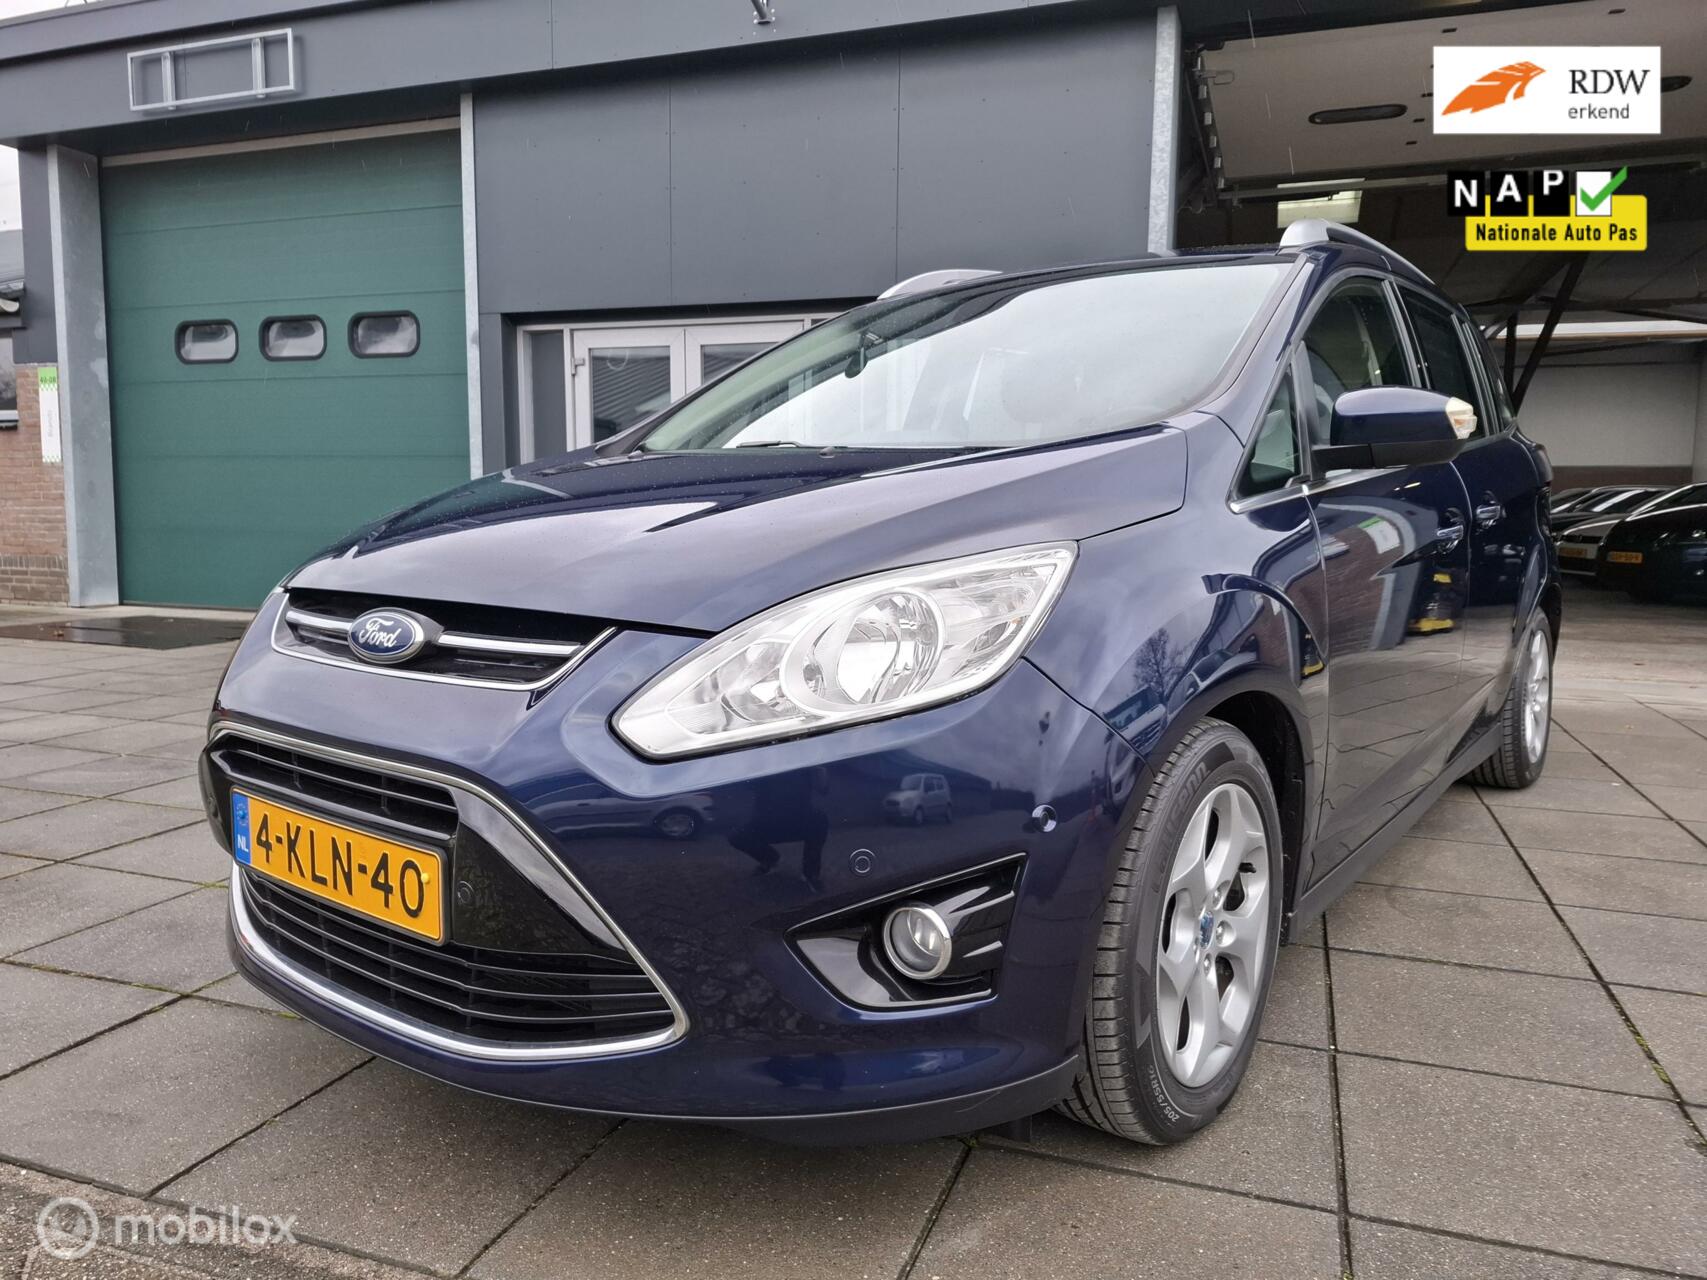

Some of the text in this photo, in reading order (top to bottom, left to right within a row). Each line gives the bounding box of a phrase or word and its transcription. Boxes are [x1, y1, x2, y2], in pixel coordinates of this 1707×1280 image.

[359, 617, 402, 648] Ford
[237, 834, 249, 852] NL
[256, 813, 425, 918] 4-KLN-40
[1147, 1064, 1180, 1122] 205/55R16
